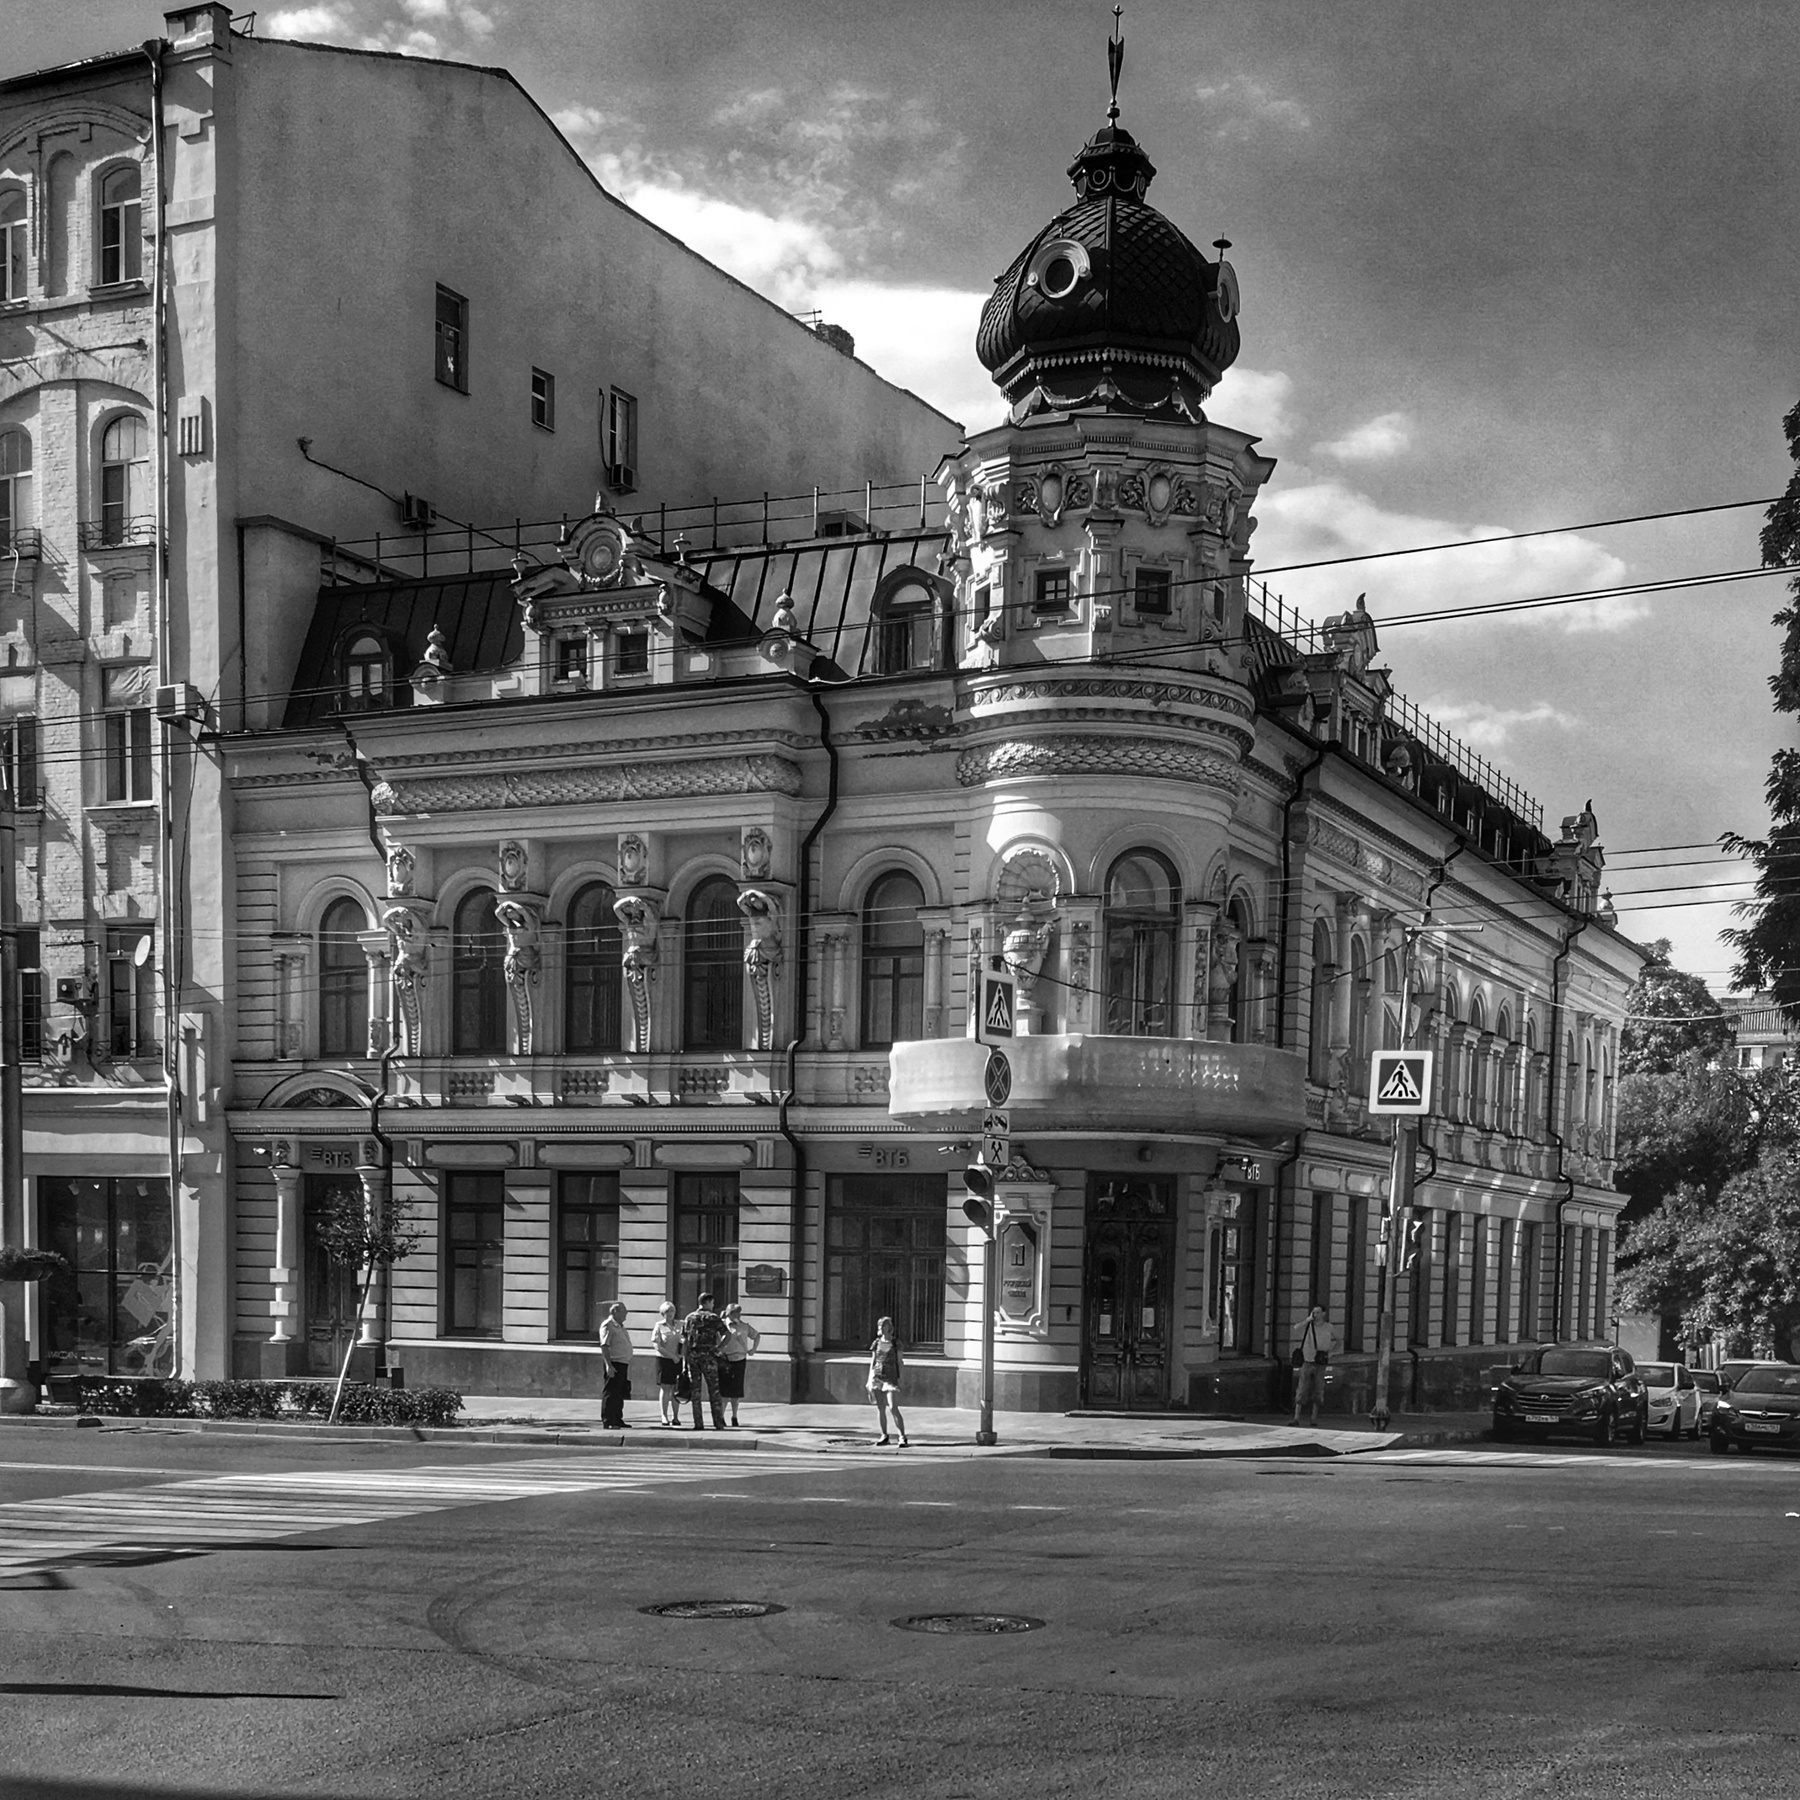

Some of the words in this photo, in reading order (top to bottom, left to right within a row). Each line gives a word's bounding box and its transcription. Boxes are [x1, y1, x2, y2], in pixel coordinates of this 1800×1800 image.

[323, 1151, 352, 1167] ВТБ
[874, 1148, 909, 1167] ВТБ
[1247, 1163, 1260, 1181] ВТБ
